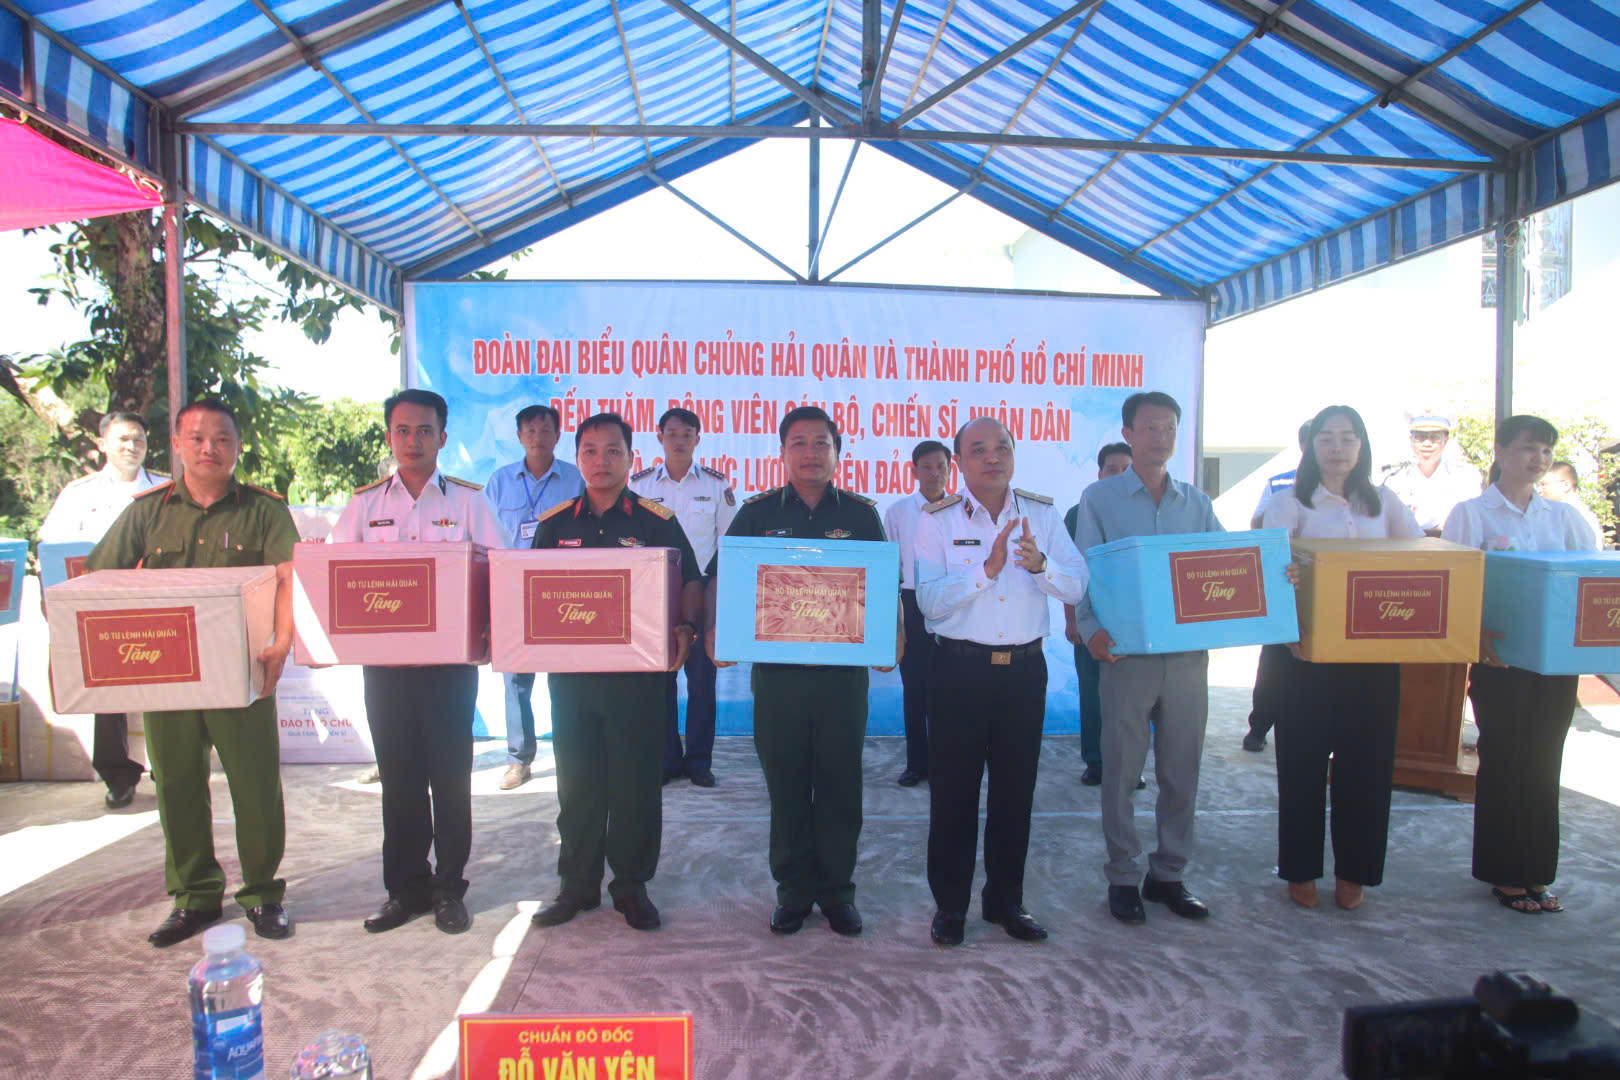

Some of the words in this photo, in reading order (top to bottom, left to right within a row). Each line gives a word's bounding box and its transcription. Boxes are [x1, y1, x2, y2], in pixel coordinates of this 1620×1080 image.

[473, 332, 531, 376] ĐOÀN
[536, 339, 571, 383] ĐẠI
[577, 326, 625, 376] BIỂU
[631, 332, 688, 379] QUÂN
[694, 329, 765, 377] CHỦNG
[770, 330, 805, 377] HẢI
[811, 336, 867, 382] QUÂN
[873, 338, 899, 380] VÀ
[903, 340, 970, 383] THÀNH
[975, 337, 1016, 385] PHỐ
[1020, 339, 1048, 386] HỒ
[1053, 345, 1087, 387] CHÍ
[1091, 353, 1145, 388] MINH
[730, 392, 778, 435] VIÊN
[832, 394, 866, 444] BỘ,
[872, 393, 932, 439] CHIẾN
[937, 398, 960, 440] SĨ
[1029, 401, 1071, 442] DÂN
[832, 452, 870, 495] RÊN
[874, 448, 916, 496] ĐẢO
[363, 591, 403, 613] Tặng
[1201, 580, 1237, 601] Tặng
[557, 602, 598, 625] Tặng
[1378, 600, 1416, 621] Tặng
[122, 630, 141, 641] LỆNH
[141, 628, 156, 639] HẢI
[156, 627, 177, 638] QUÂN
[118, 641, 163, 665] Tặng
[575, 1026, 599, 1043] ĐÔ
[601, 1025, 635, 1043] ĐỐC
[498, 1046, 535, 1080] ĐỖ
[541, 1051, 597, 1080] VĂN
[603, 1049, 656, 1080] YÊN
